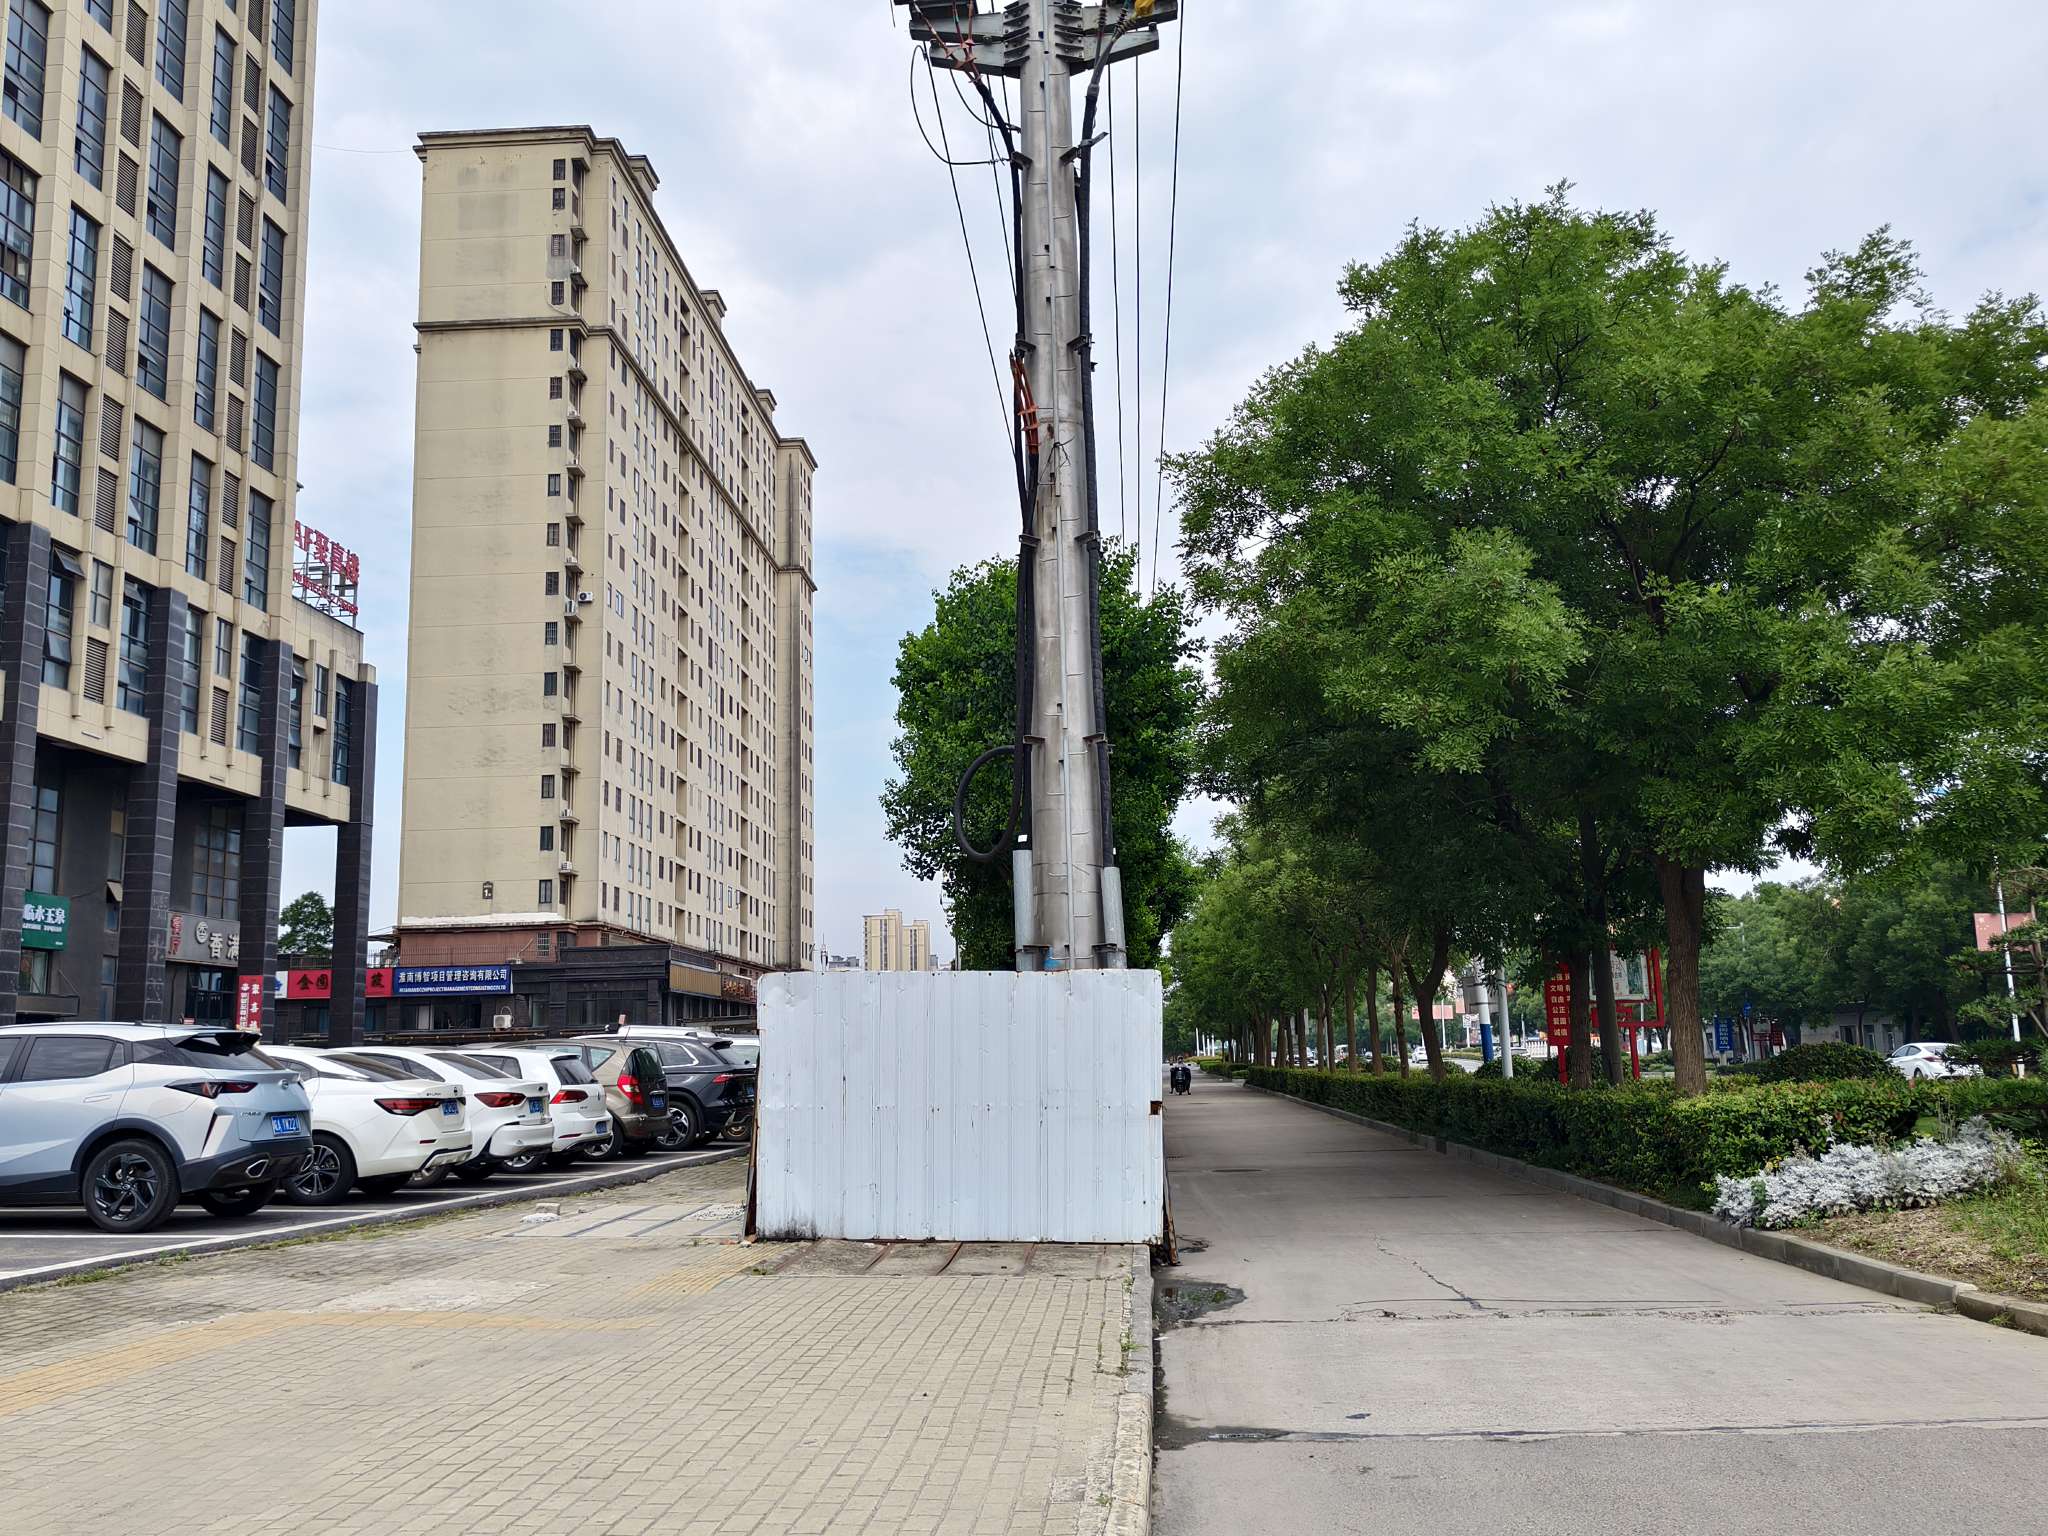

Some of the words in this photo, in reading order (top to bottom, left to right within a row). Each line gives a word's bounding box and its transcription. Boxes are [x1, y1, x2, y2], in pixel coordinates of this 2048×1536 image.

[398, 969, 508, 984] 淮南博智项目管理咨询有限公司
[1550, 985, 1564, 993] 文明
[1552, 1006, 1566, 1014] 公正
[1554, 1029, 1568, 1037] 诚信
